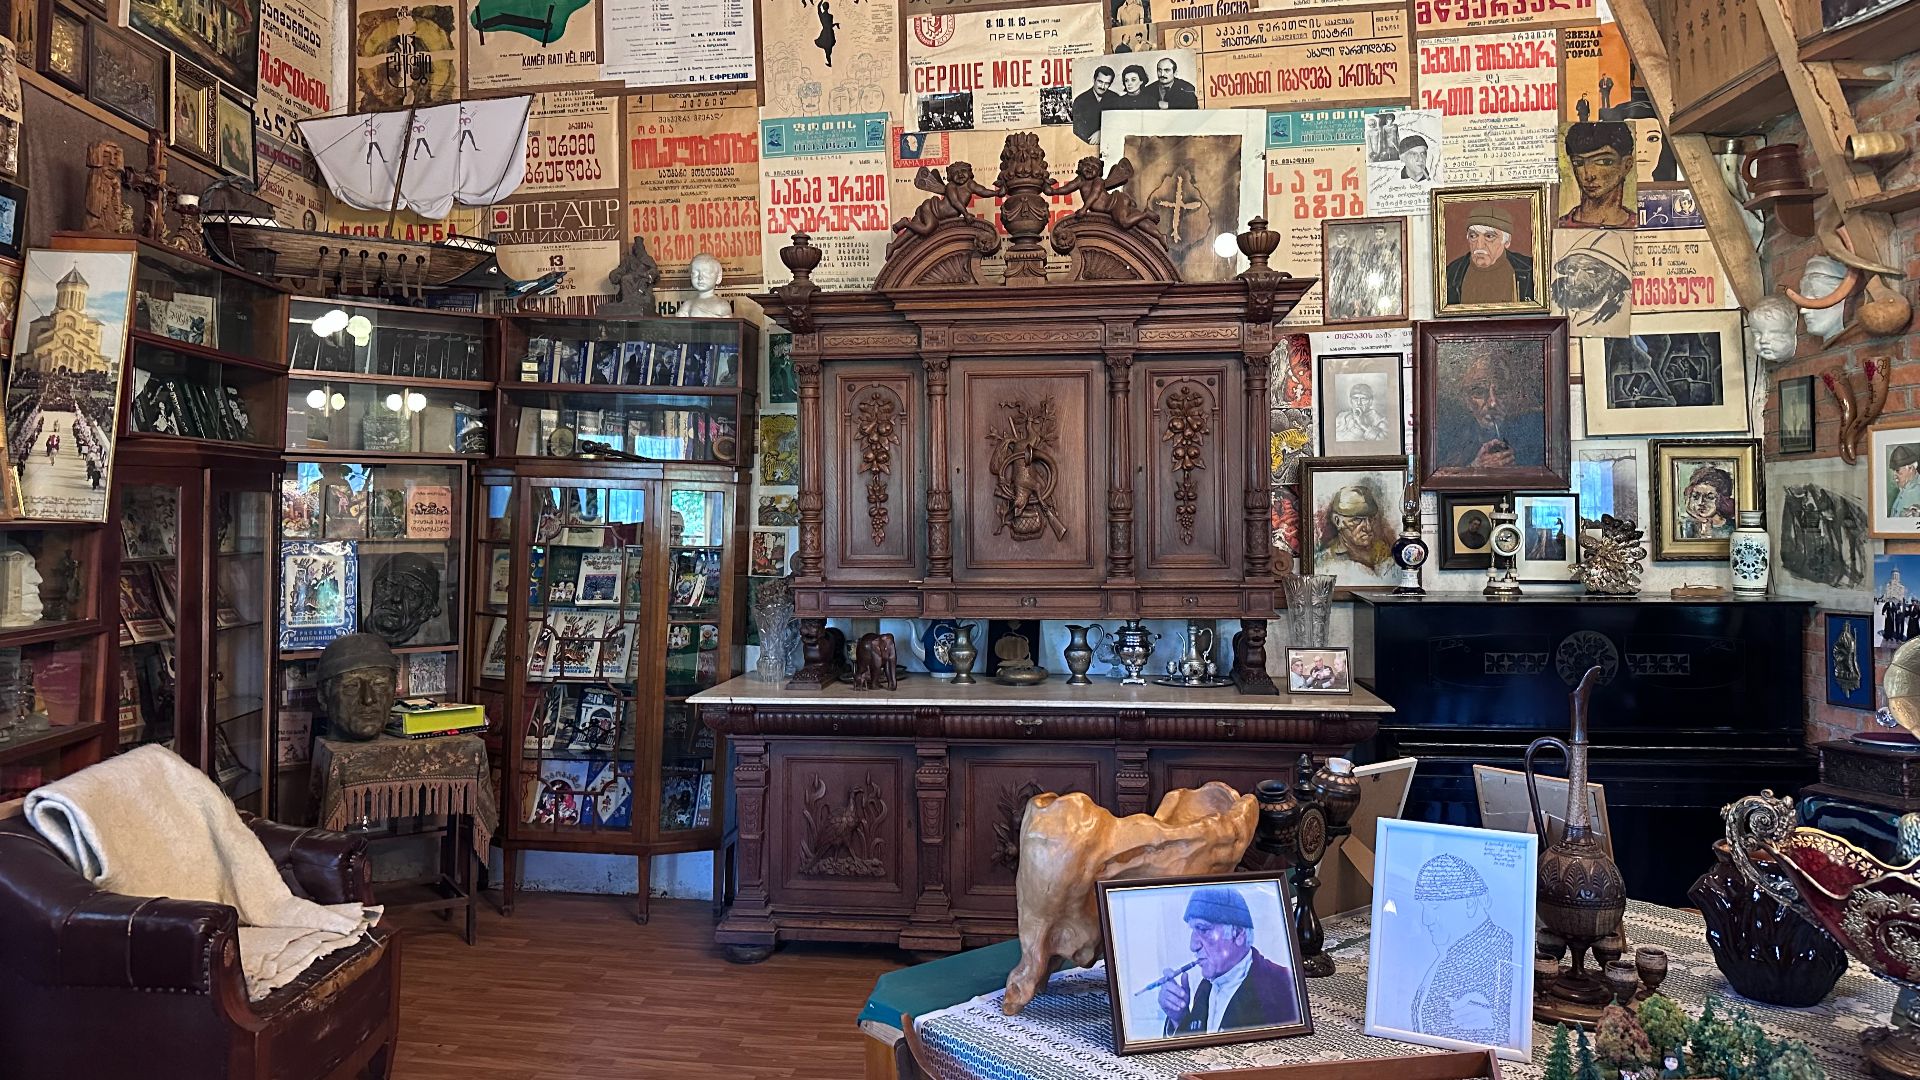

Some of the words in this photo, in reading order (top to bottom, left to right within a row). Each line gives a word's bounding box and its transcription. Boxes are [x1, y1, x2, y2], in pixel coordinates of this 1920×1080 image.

[1018, 16, 1026, 27] 13
[989, 29, 1058, 42] ПРЕМЬЕРА
[1216, 24, 1249, 36] აკაკი
[1312, 28, 1353, 40] თეატრი
[1565, 30, 1603, 39] ЗВЕЗДА
[1565, 40, 1600, 49] МОЕГО
[547, 53, 563, 65] RATI
[580, 51, 596, 63] RIPO
[1306, 46, 1335, 59] ახალი
[1565, 48, 1603, 59] ГОРОДА
[1421, 46, 1471, 74] ექვსი
[709, 72, 749, 81] ЕФРЕМОВ
[914, 62, 984, 93] СЕРДЦЕ
[993, 60, 1032, 88] МОЕ
[1209, 71, 1271, 98] ადამიანი
[1277, 65, 1332, 92] იბადება
[1338, 61, 1397, 88] ერთხელ
[1422, 87, 1474, 116] ერთი
[637, 125, 674, 135] ოტია
[547, 133, 596, 157] ურემი
[521, 158, 602, 184] ბრუნდება
[771, 177, 822, 205] სანამ
[827, 174, 885, 203] ურემი
[514, 199, 620, 231] ТЕАТР
[768, 204, 889, 234] გადაბრუნდება
[539, 231, 550, 243] И
[653, 234, 695, 262] ერთი
[549, 255, 564, 267] 13
